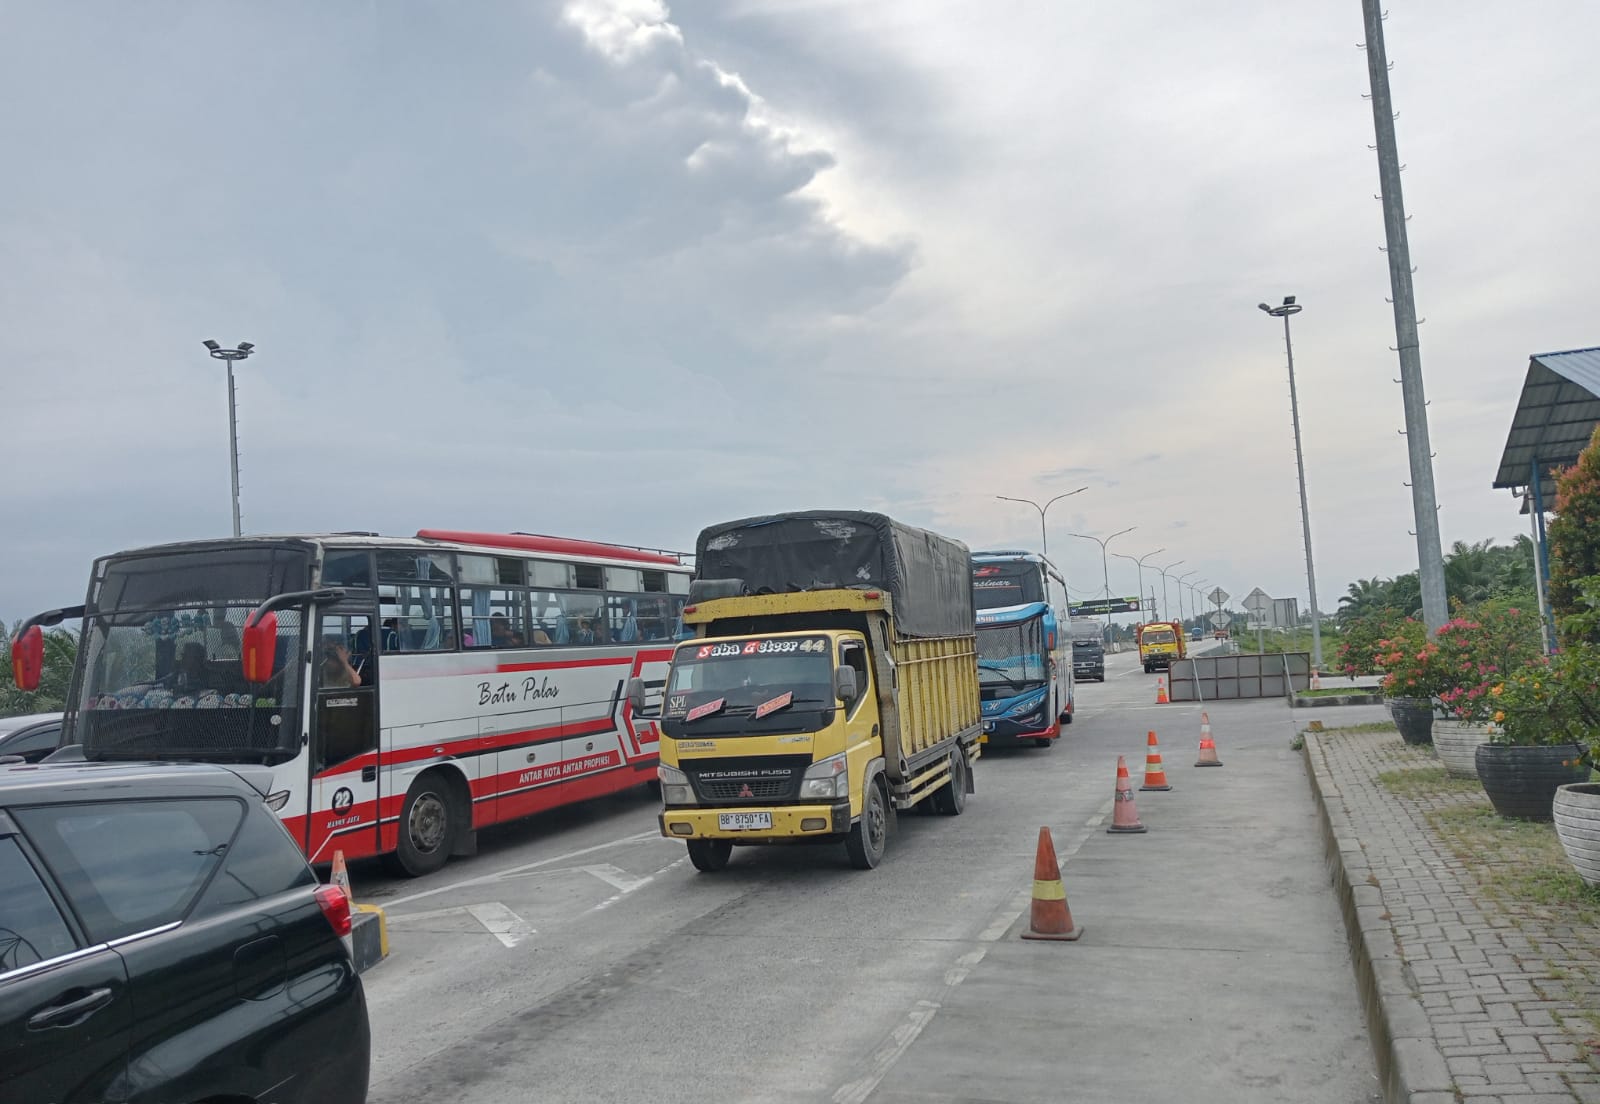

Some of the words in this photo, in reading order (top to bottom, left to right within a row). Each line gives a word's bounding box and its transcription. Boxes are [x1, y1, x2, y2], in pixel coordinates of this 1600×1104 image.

[699, 643, 740, 658] Saba
[800, 640, 825, 653] 44
[477, 681, 517, 706] Batu
[521, 676, 560, 701] Palas
[670, 696, 687, 708] SPL
[519, 770, 543, 784] ANTAR
[543, 766, 561, 779] KOTA
[562, 762, 583, 775] ANTAR
[583, 756, 610, 769] PROPINSI
[699, 770, 758, 778] MITSUBISHI
[334, 791, 351, 808] 22
[759, 813, 769, 823] FA
